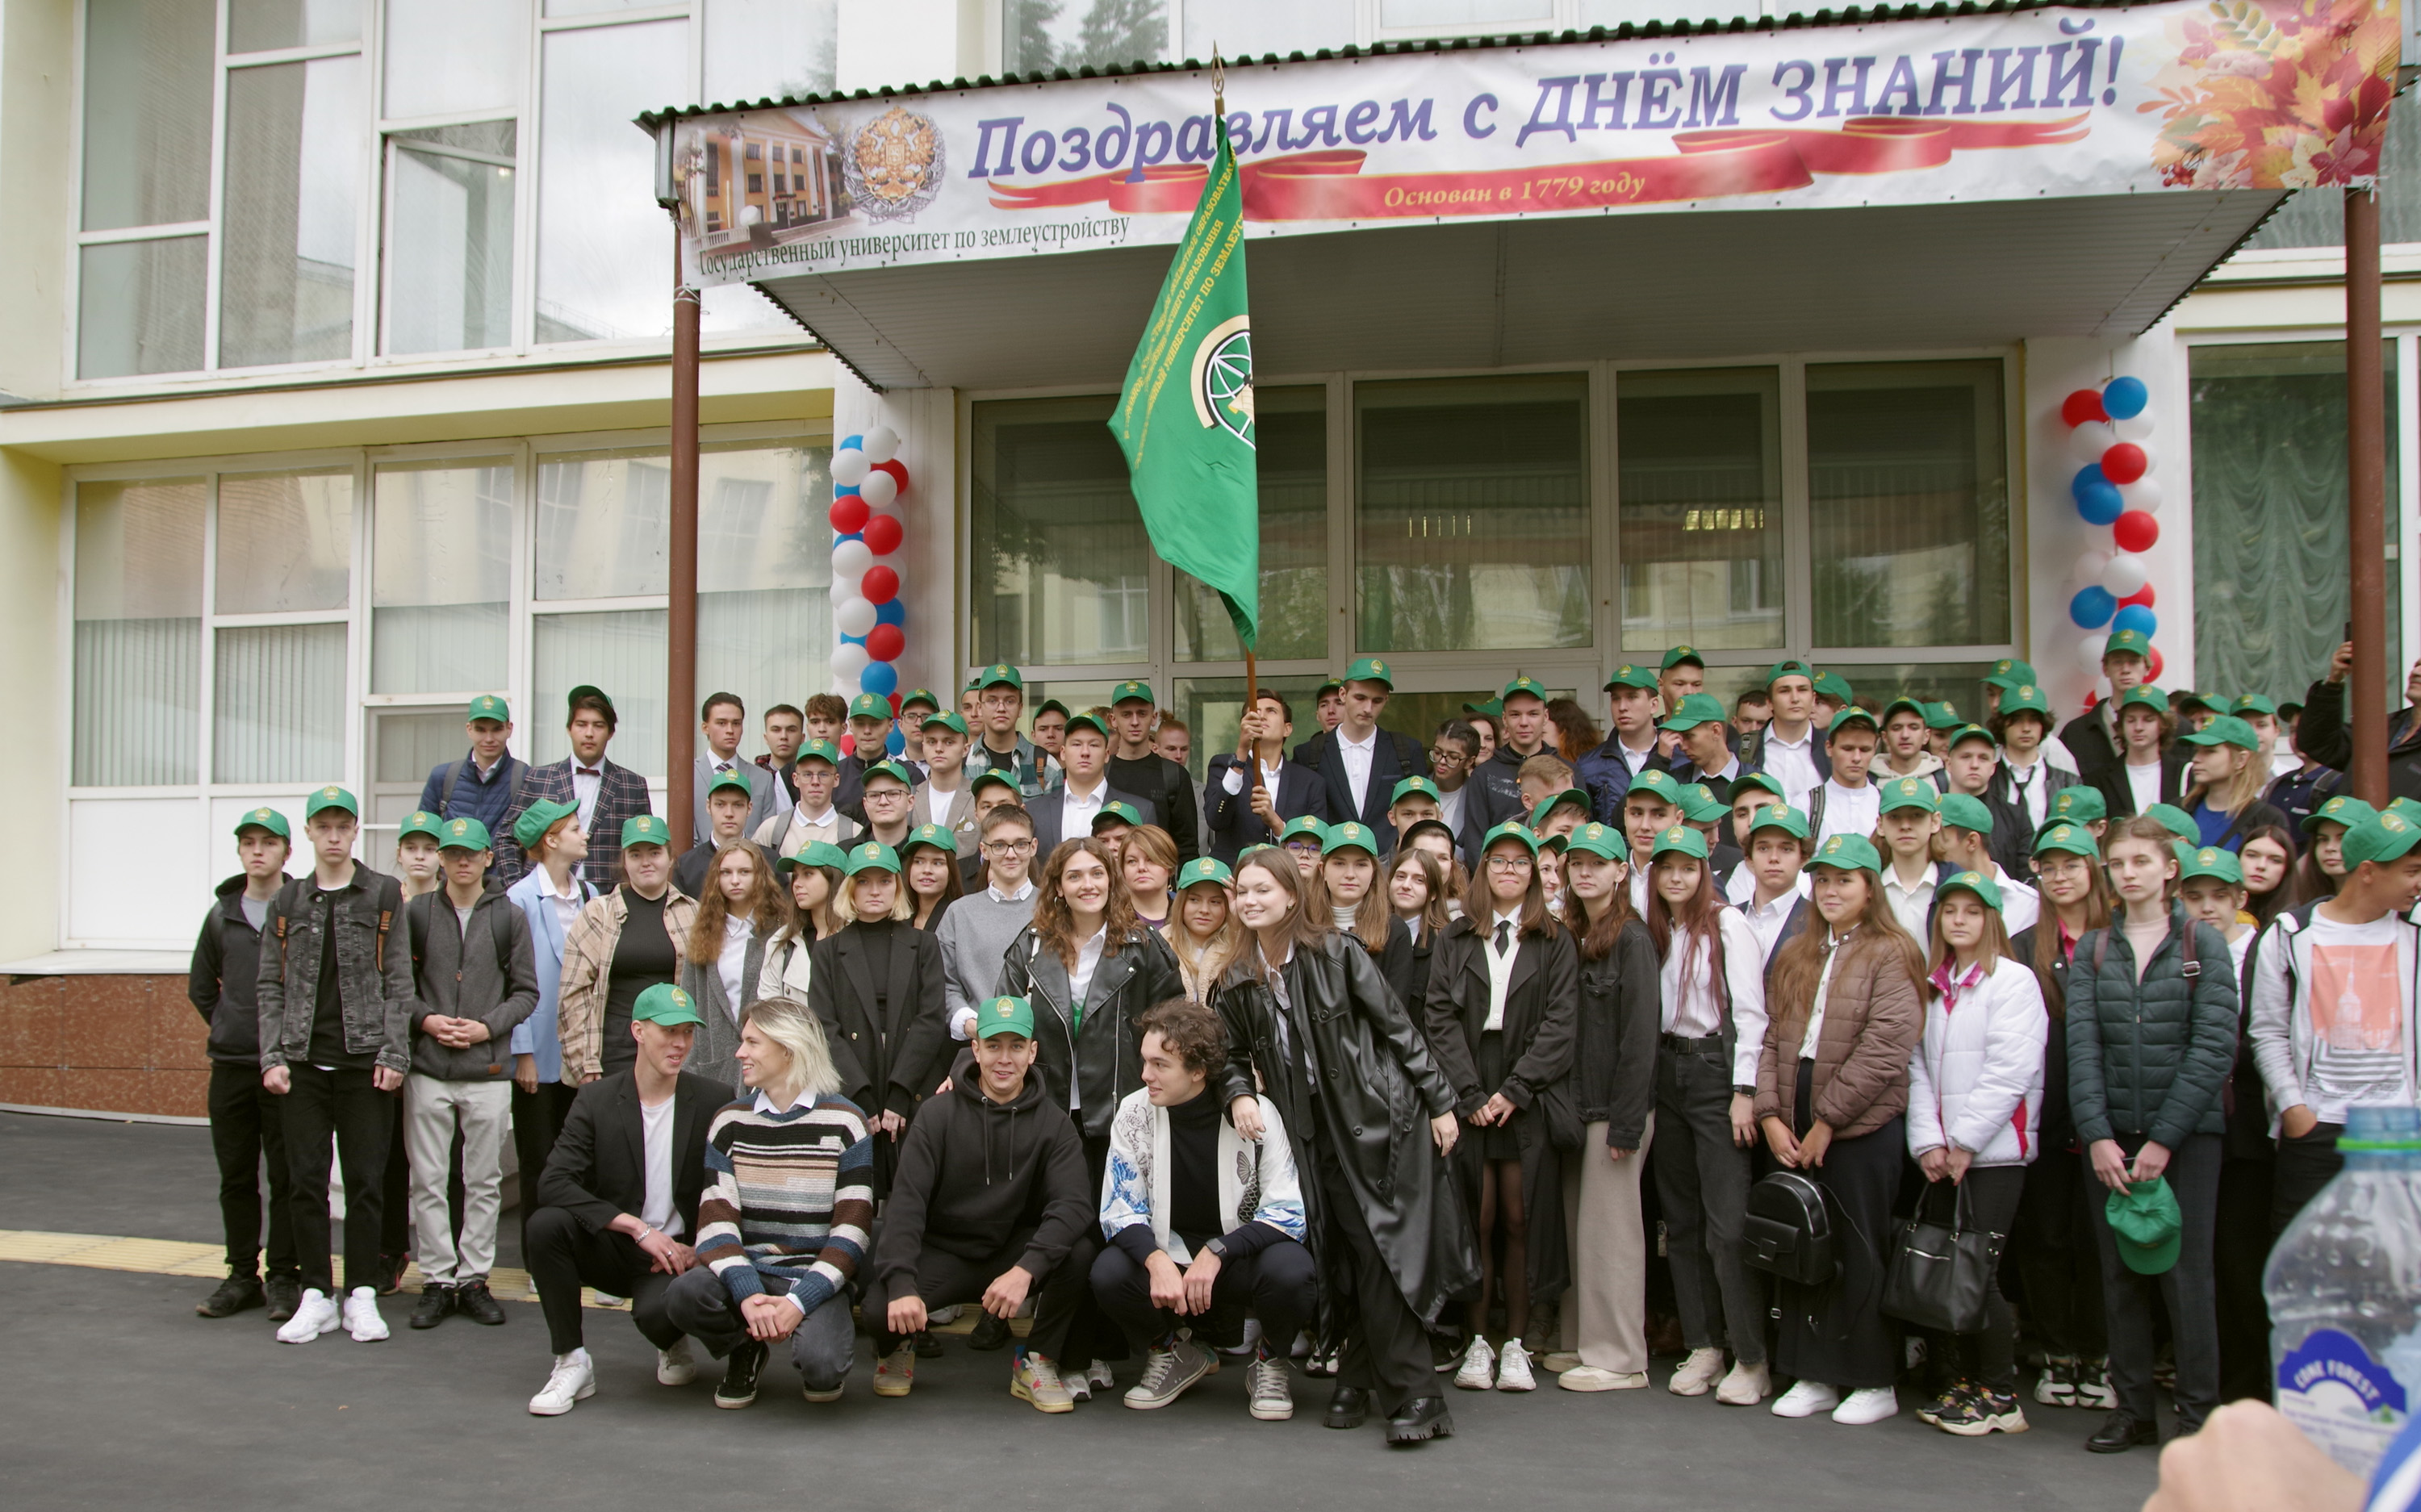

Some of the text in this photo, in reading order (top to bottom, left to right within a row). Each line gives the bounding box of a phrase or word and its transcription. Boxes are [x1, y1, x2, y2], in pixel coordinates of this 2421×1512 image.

[968, 17, 2124, 184] Поздравляем с ДНЁМ ЗНАНИЙ!
[1384, 171, 1646, 207] Основан в 1779 году
[699, 215, 1131, 281] Государственный университет по землеустройству
[1183, 219, 1224, 290] ОБРАЗОВАНИЯ
[1164, 294, 1205, 371] УНИВЕРСИТЕТ
[1199, 277, 1215, 297] ПО
